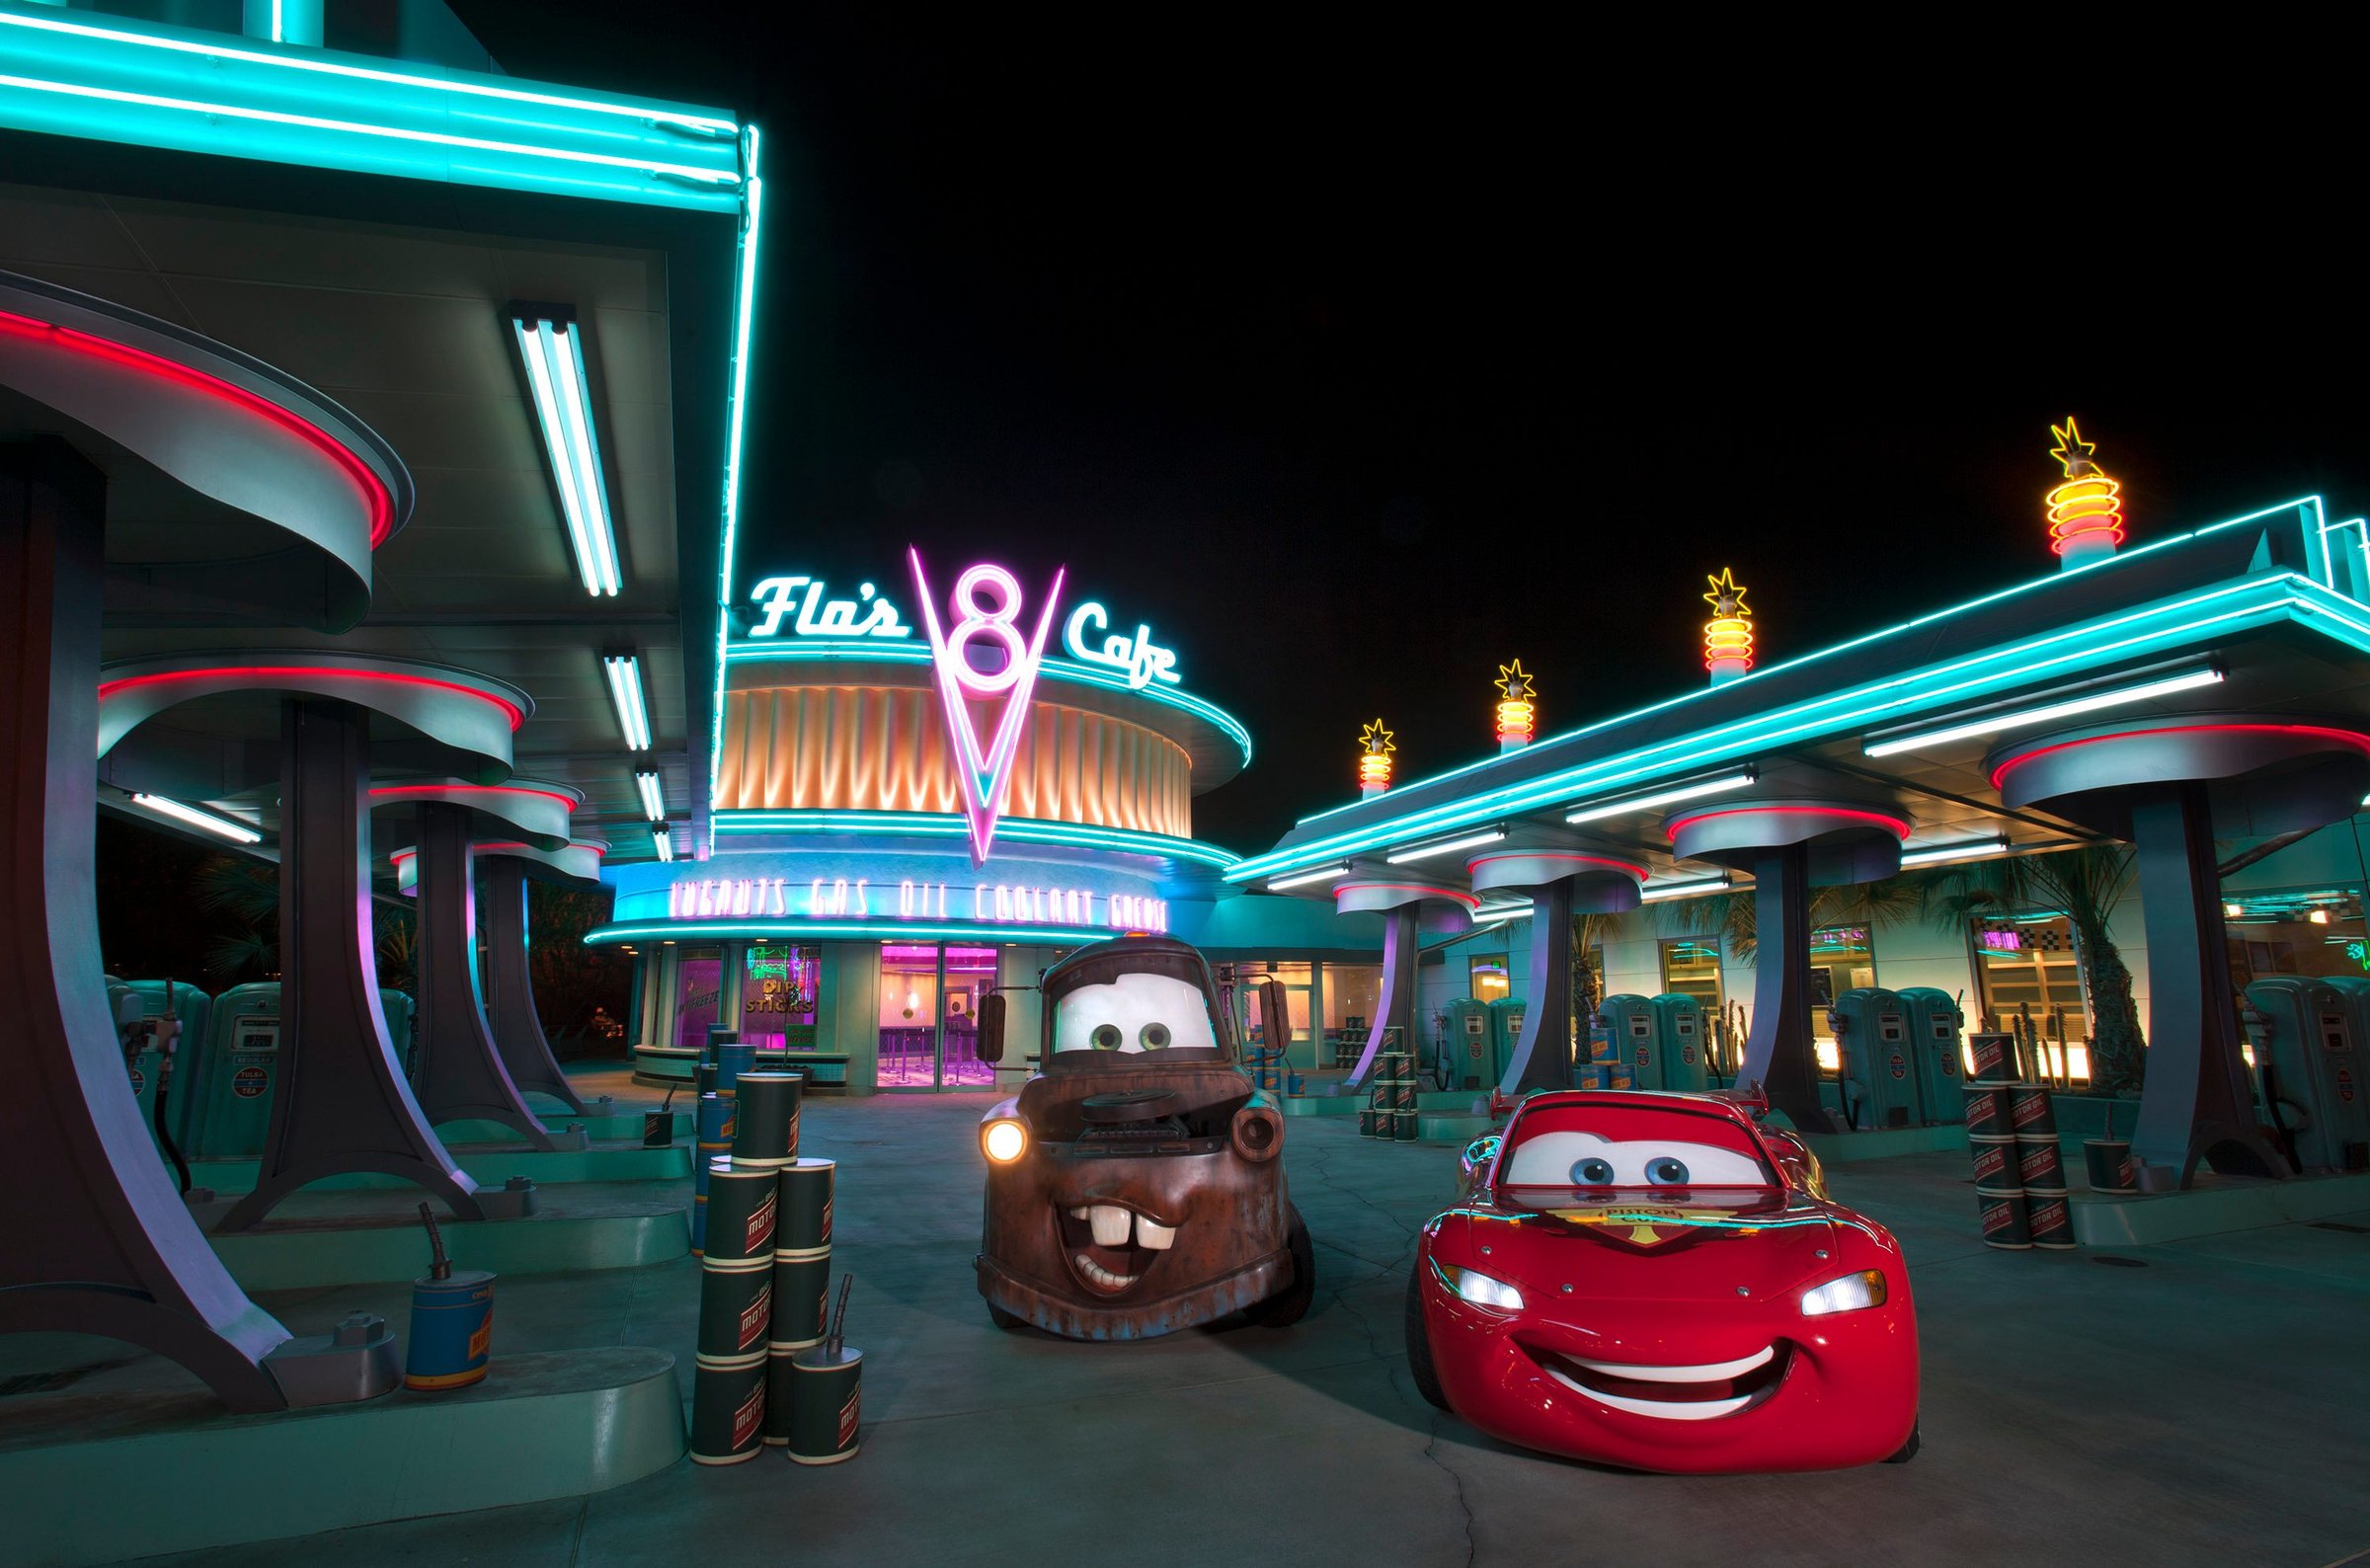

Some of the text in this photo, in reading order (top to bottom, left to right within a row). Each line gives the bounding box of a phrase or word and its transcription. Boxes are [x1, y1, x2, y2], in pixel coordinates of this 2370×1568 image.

[750, 576, 912, 638] Flo's
[1064, 601, 1181, 689] Cafe
[811, 878, 868, 916] GAS
[901, 880, 947, 917] OIL
[976, 884, 1092, 924] COOLANT
[762, 980, 795, 994] DIP
[746, 999, 815, 1013] STICKS
